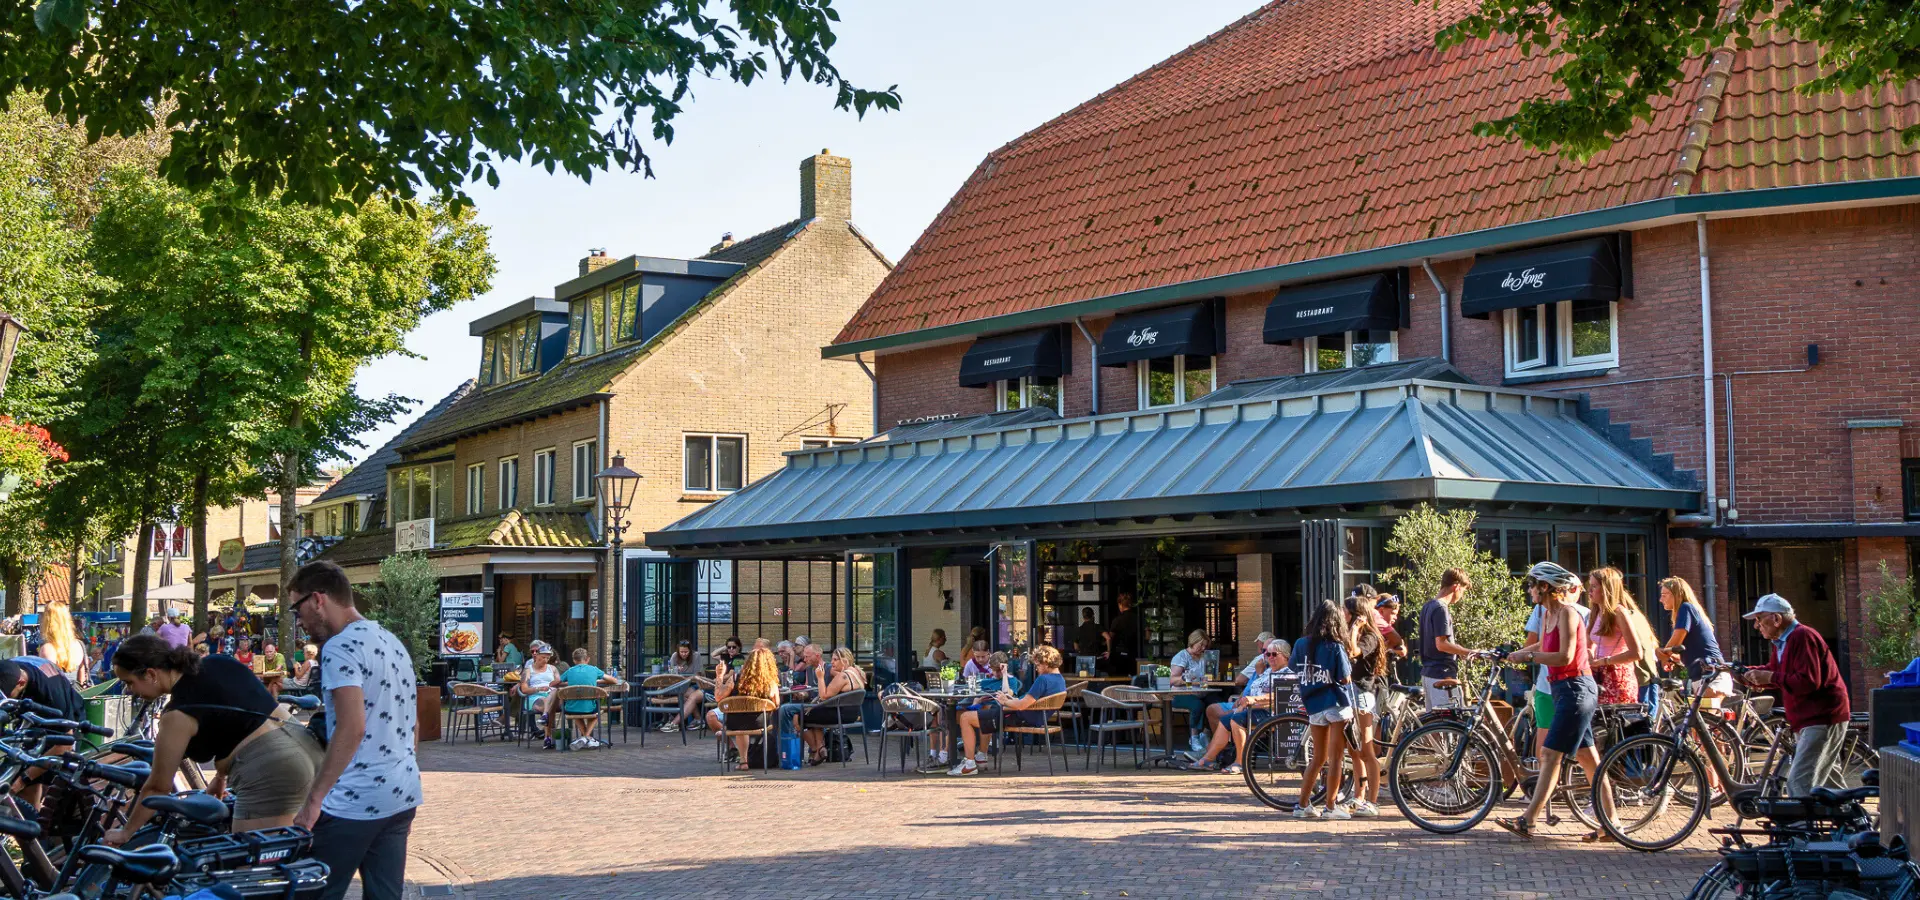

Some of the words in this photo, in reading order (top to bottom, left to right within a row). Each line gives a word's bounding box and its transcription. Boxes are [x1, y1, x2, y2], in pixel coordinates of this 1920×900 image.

[1501, 272, 1515, 288] de
[1511, 267, 1547, 291] Jong
[1296, 307, 1334, 318] RESTAURANT
[984, 356, 1012, 366] RESTAURANT
[445, 596, 461, 605] METZ
[469, 596, 481, 605] VIS
[249, 849, 289, 862] EWIET
